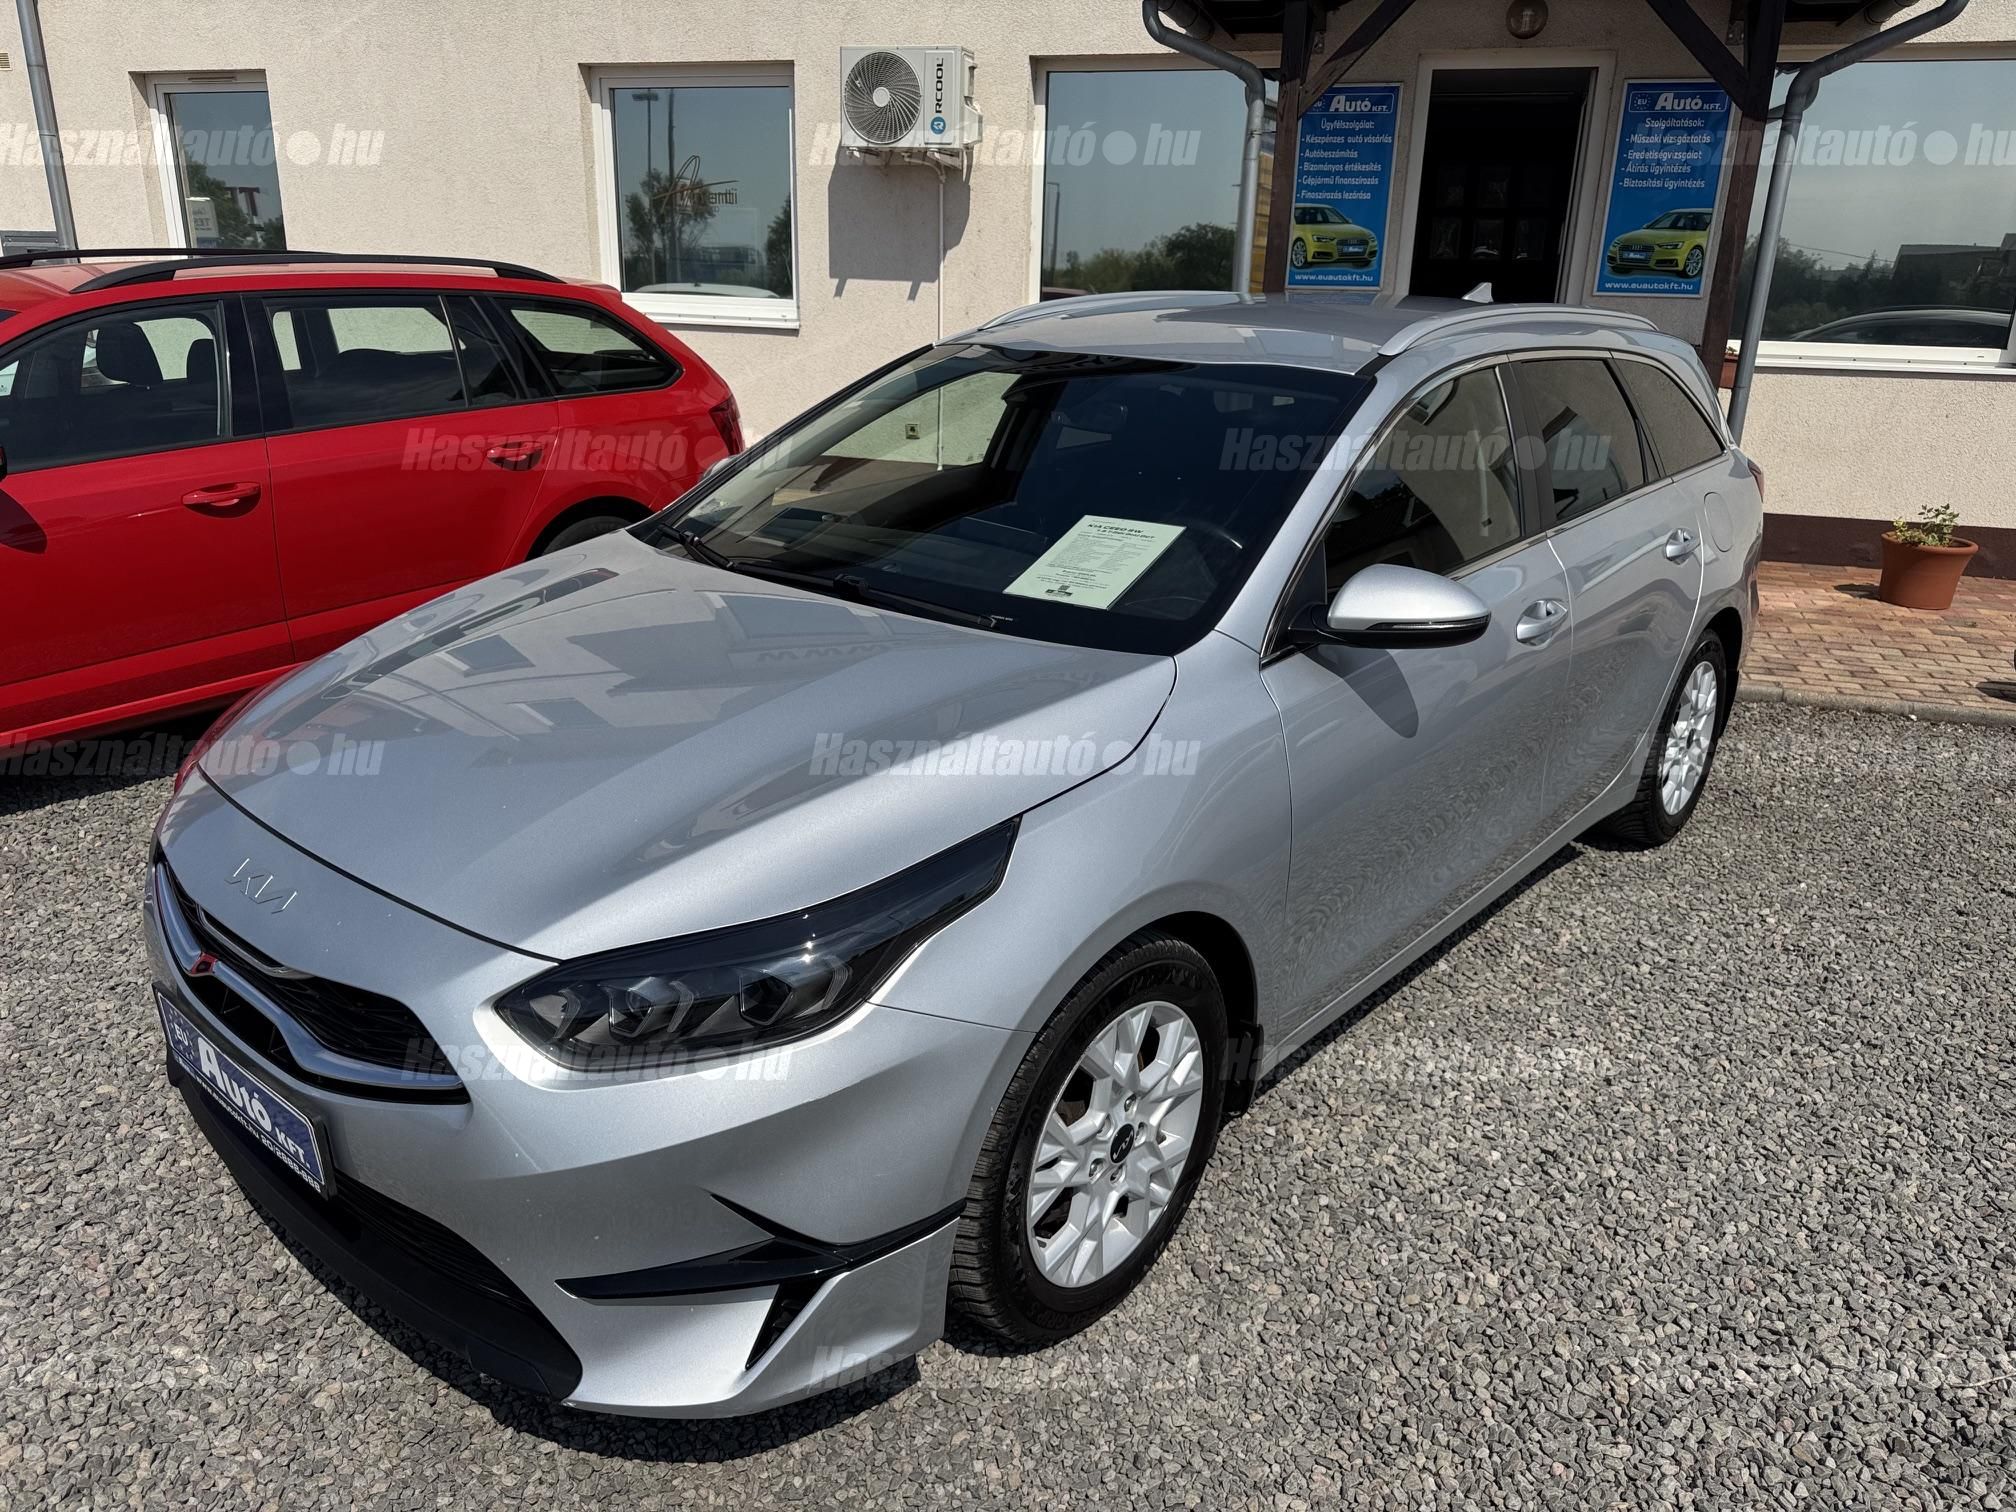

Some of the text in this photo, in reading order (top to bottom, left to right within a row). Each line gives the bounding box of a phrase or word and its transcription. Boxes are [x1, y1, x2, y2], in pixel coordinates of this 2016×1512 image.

[935, 58, 944, 113] RCOOL
[1329, 95, 1371, 112] Autó
[1654, 92, 1702, 111] Autó
[1320, 118, 1375, 131] Ügyfélszolgálat:
[1644, 117, 1705, 129] Szolgáltatások:
[1347, 135, 1362, 143] autó
[1363, 133, 1392, 143] vásárlás
[1294, 273, 1373, 282] www.euautokft.hu
[1604, 281, 1693, 290] www.euautokft.hu
[174, 1022, 189, 1046] EU
[198, 1037, 272, 1132] Autó
[275, 1127, 311, 1169] KFT.
